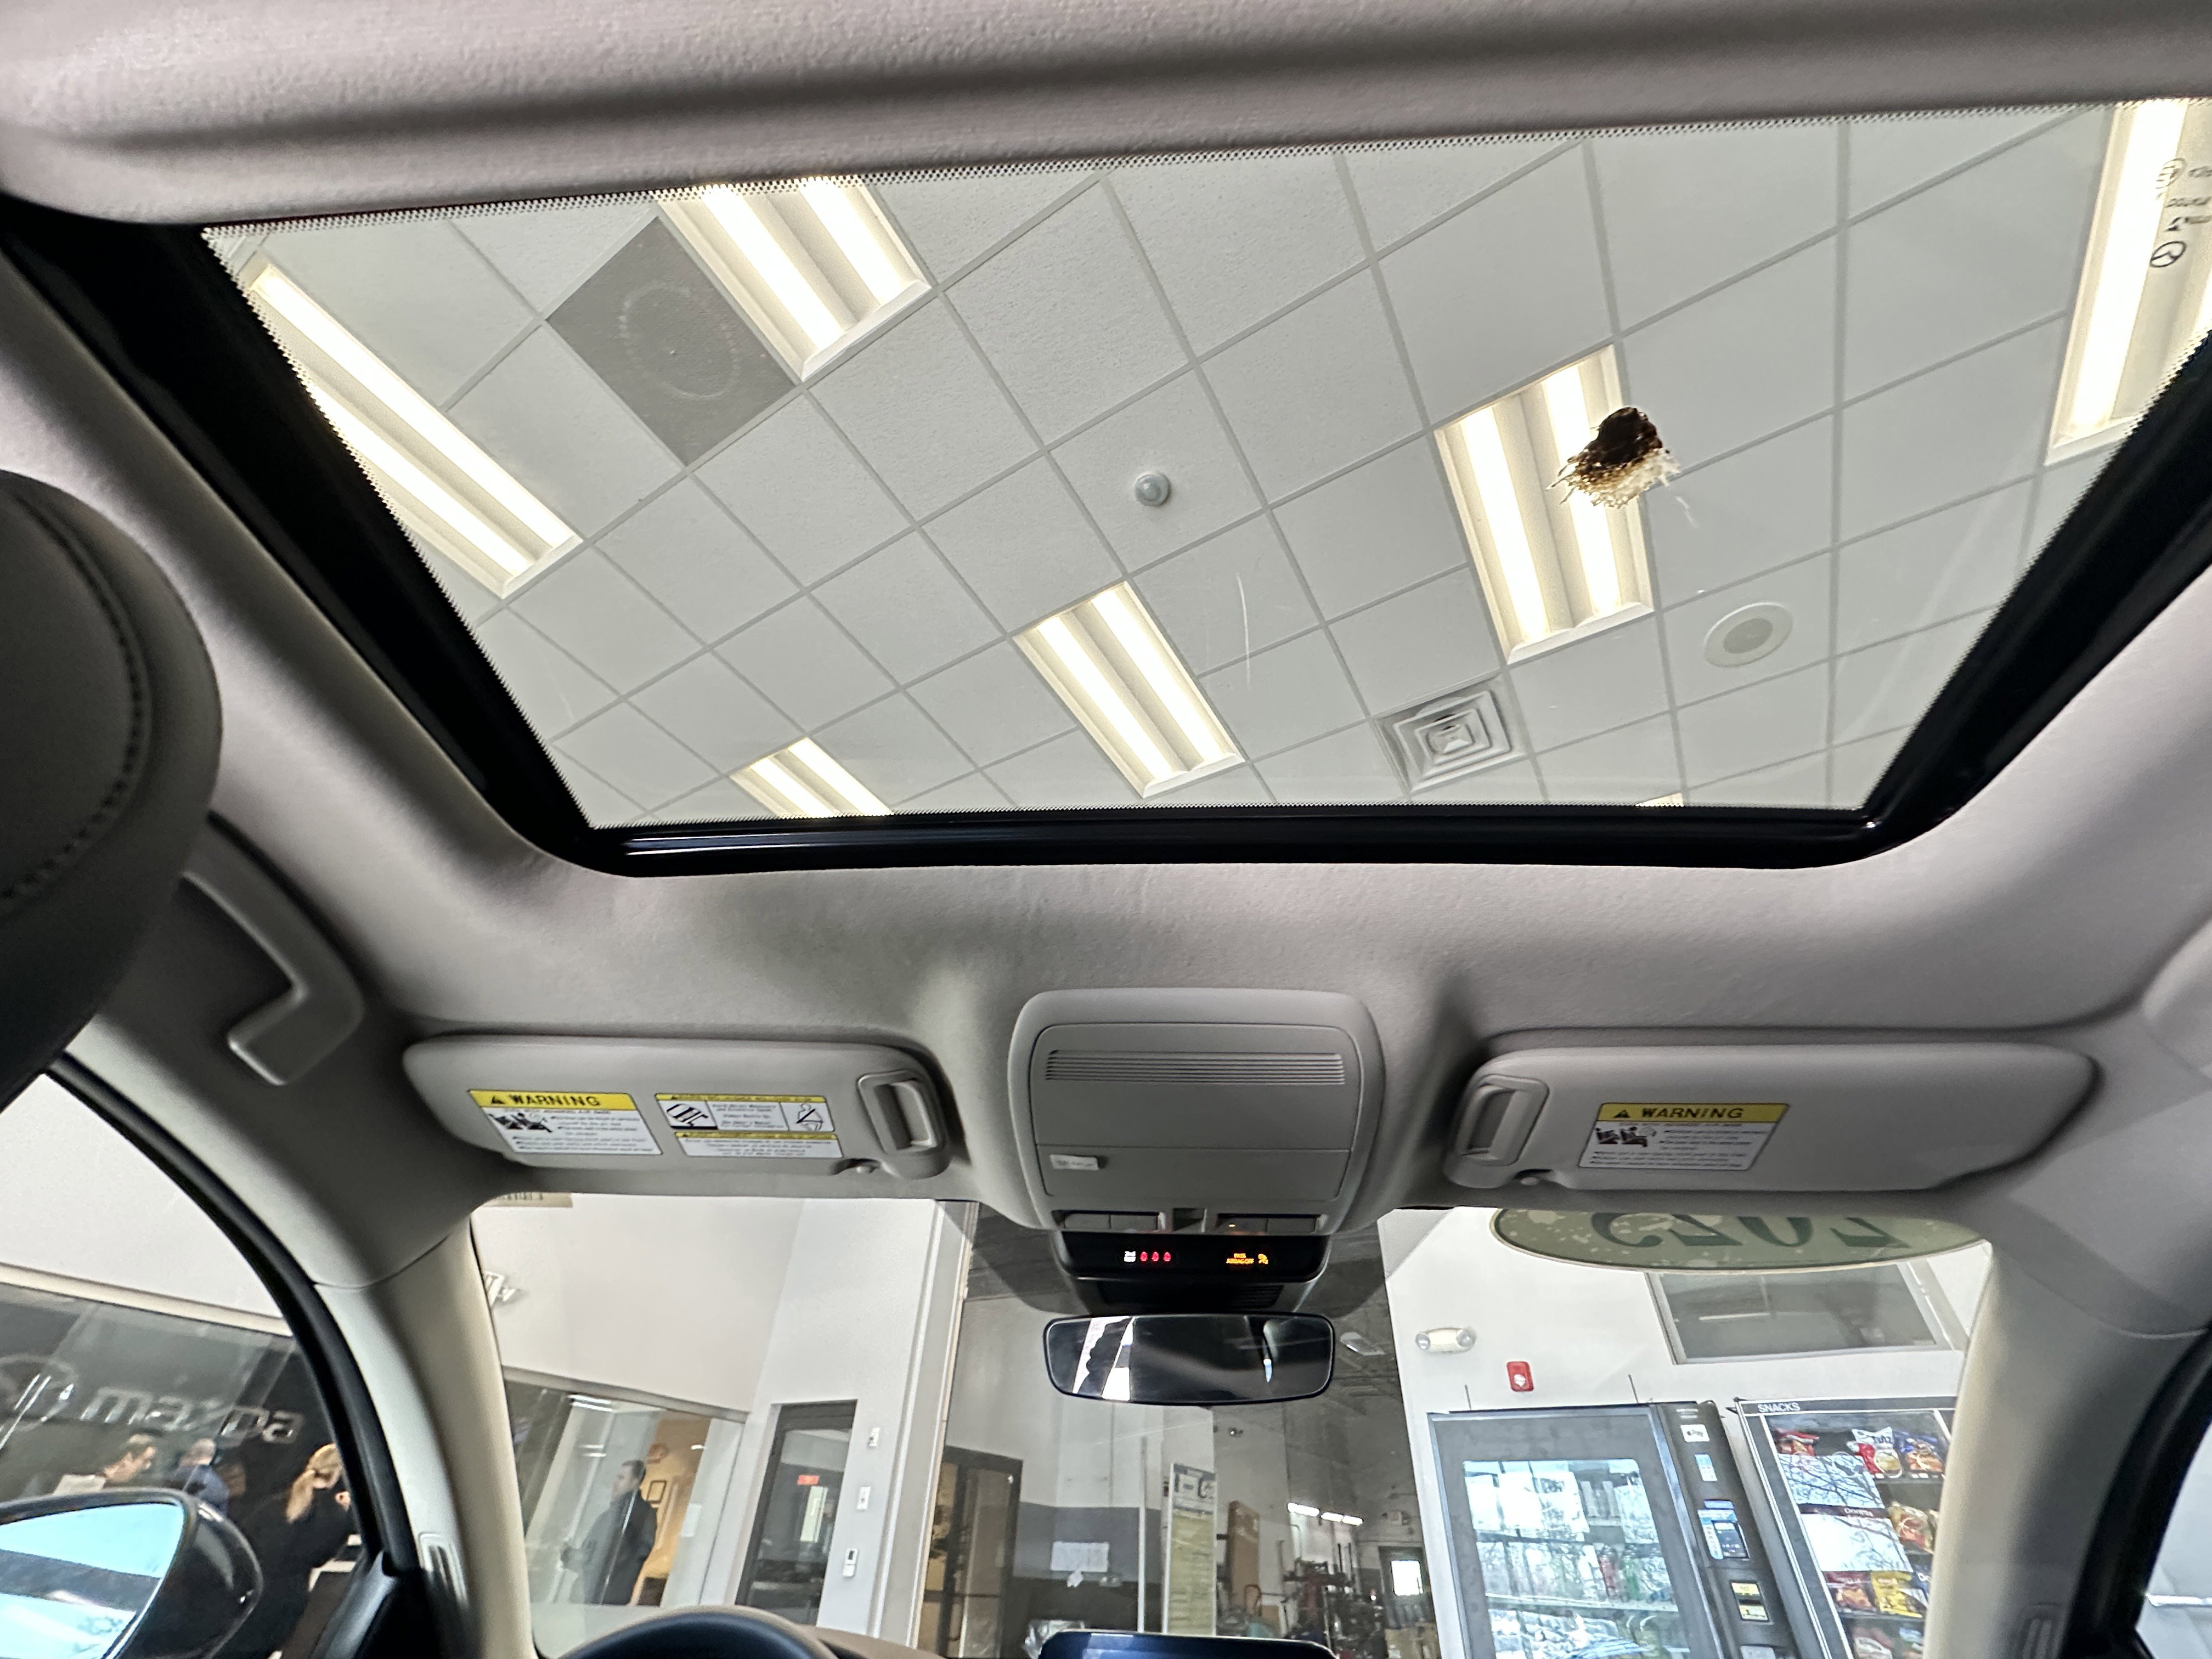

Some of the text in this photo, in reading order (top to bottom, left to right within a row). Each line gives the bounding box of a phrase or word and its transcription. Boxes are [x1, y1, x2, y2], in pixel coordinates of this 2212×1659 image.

[508, 1094, 601, 1107] WARNING
[1641, 1107, 1745, 1119] WARNING
[1757, 1402, 1801, 1413] SNACKS
